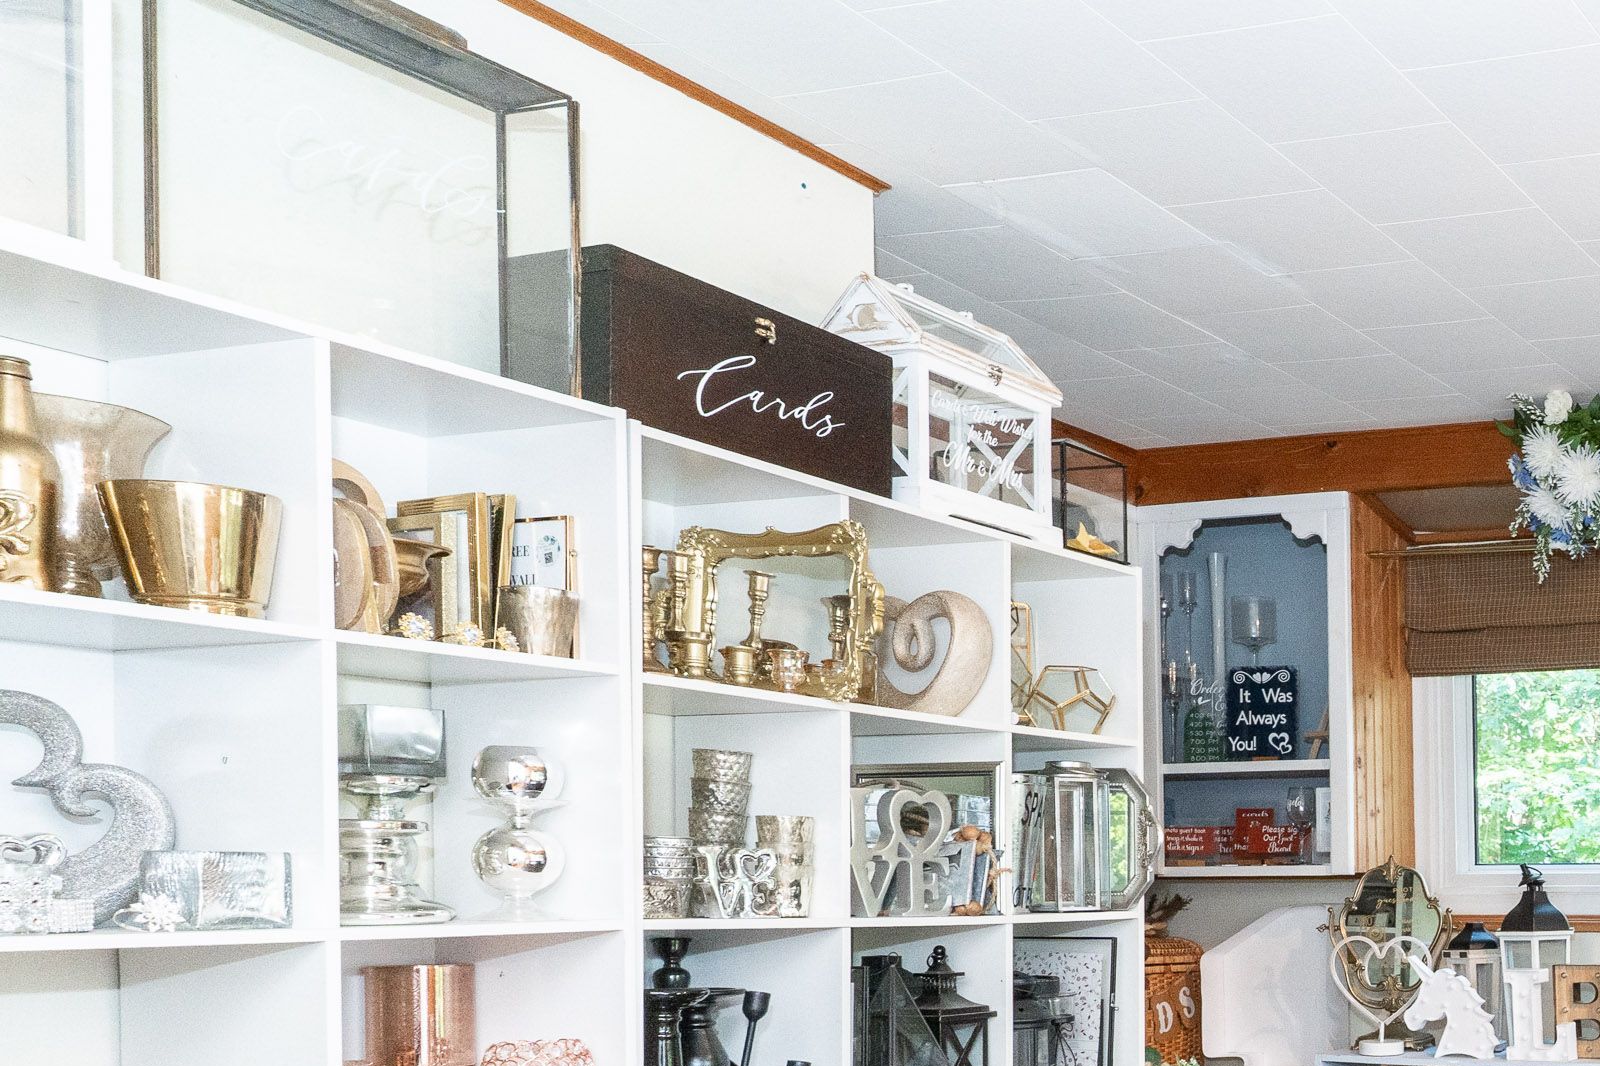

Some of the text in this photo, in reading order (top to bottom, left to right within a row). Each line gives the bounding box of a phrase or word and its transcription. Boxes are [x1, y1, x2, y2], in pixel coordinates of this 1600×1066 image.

[677, 355, 846, 437] Cards
[984, 429, 998, 446] the
[943, 441, 975, 475] Mr
[1239, 688, 1251, 703] It
[1262, 688, 1293, 703] Was
[1235, 710, 1287, 728] Always
[1228, 736, 1257, 752] You!
[1262, 825, 1285, 833] Please
[1263, 834, 1277, 842] Our
[1503, 968, 1577, 1061] L
